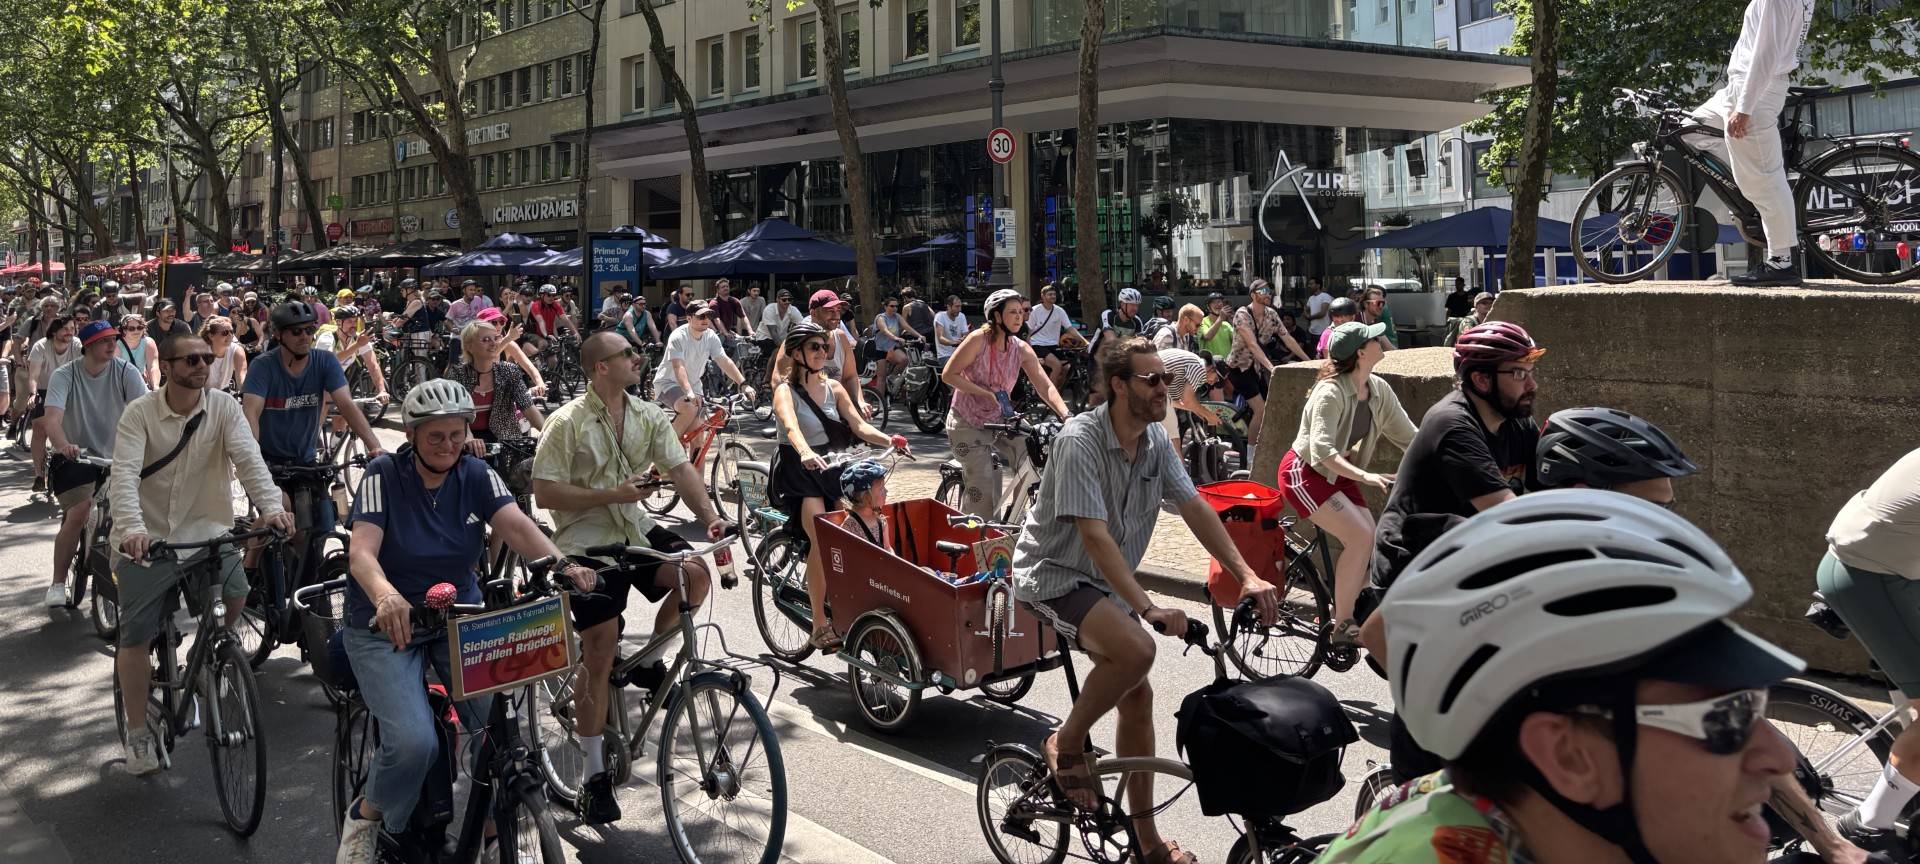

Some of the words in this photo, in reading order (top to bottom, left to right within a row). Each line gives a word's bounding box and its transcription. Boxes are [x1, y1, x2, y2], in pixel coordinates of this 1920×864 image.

[466, 122, 510, 146] ARTNER
[993, 137, 1010, 154] 30
[492, 201, 540, 224] ICHIRAKU
[540, 199, 579, 219] RAMEN
[593, 247, 615, 256] Prime
[616, 247, 630, 258] Day
[593, 256, 604, 264] ist
[593, 264, 605, 273] 23.
[609, 264, 621, 273] 26.
[621, 264, 637, 273] Juni
[869, 578, 911, 604] Bakfiets.nl
[471, 618, 501, 631] Sternfahrt
[502, 615, 516, 625] Köln
[516, 612, 522, 620] &
[523, 606, 546, 619] Fahrrad
[1459, 593, 1509, 627] GIRO
[463, 634, 505, 654] Sichere
[507, 622, 556, 643] Radwege
[463, 650, 482, 667] auf
[485, 646, 513, 662] allen
[515, 631, 562, 655] Brücken!
[1809, 694, 1854, 721] SWISS
